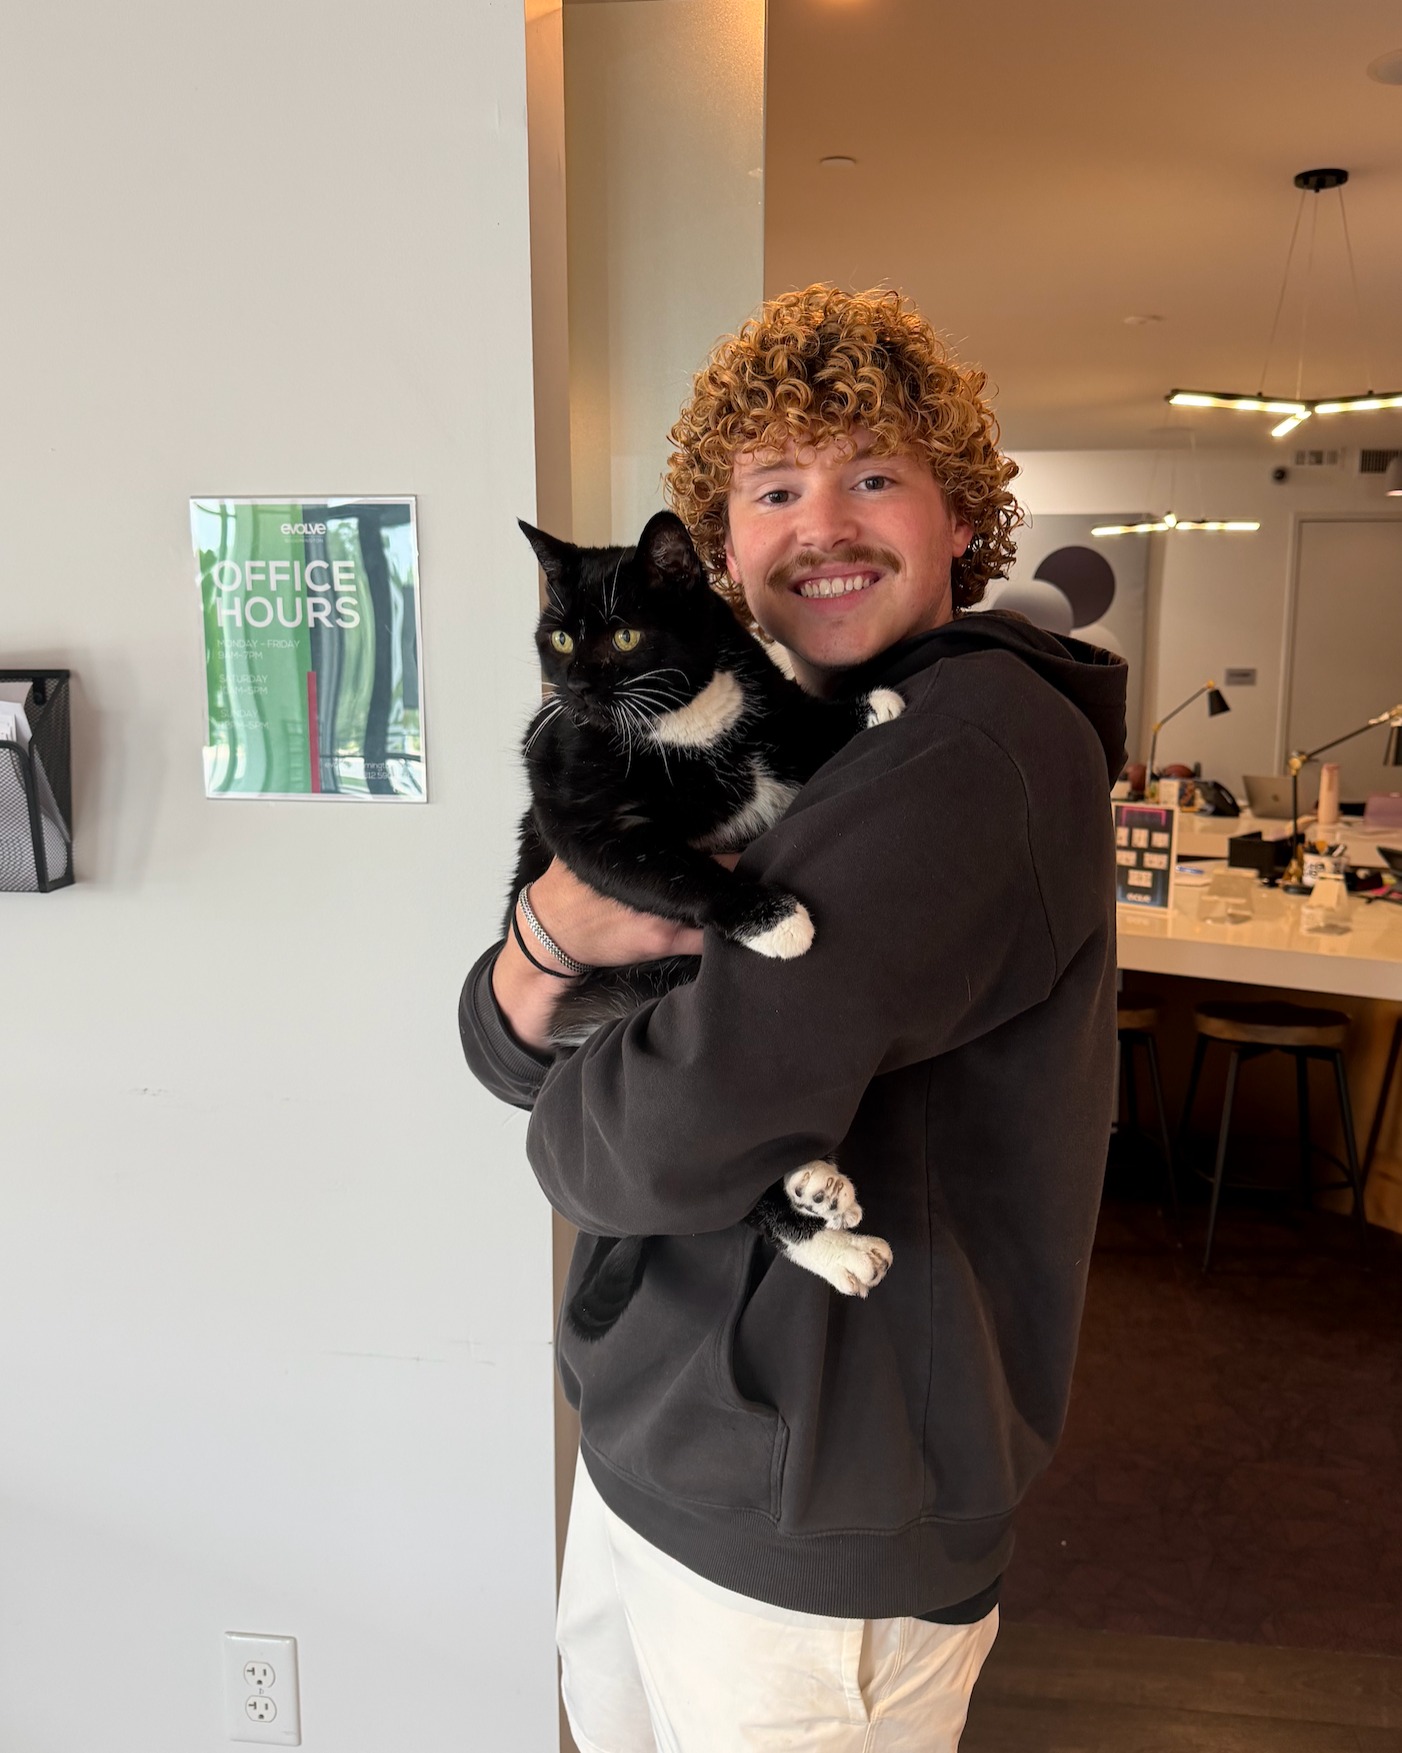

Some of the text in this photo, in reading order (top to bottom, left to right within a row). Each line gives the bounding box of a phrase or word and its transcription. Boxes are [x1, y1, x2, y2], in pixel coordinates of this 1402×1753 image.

[213, 559, 357, 592] OFFICE
[216, 596, 361, 629] HOURS
[216, 639, 258, 649] MONDAY
[267, 639, 300, 649] FRIDAY
[219, 673, 268, 684] STURDAY
[219, 685, 268, 696] 10M-5PM
